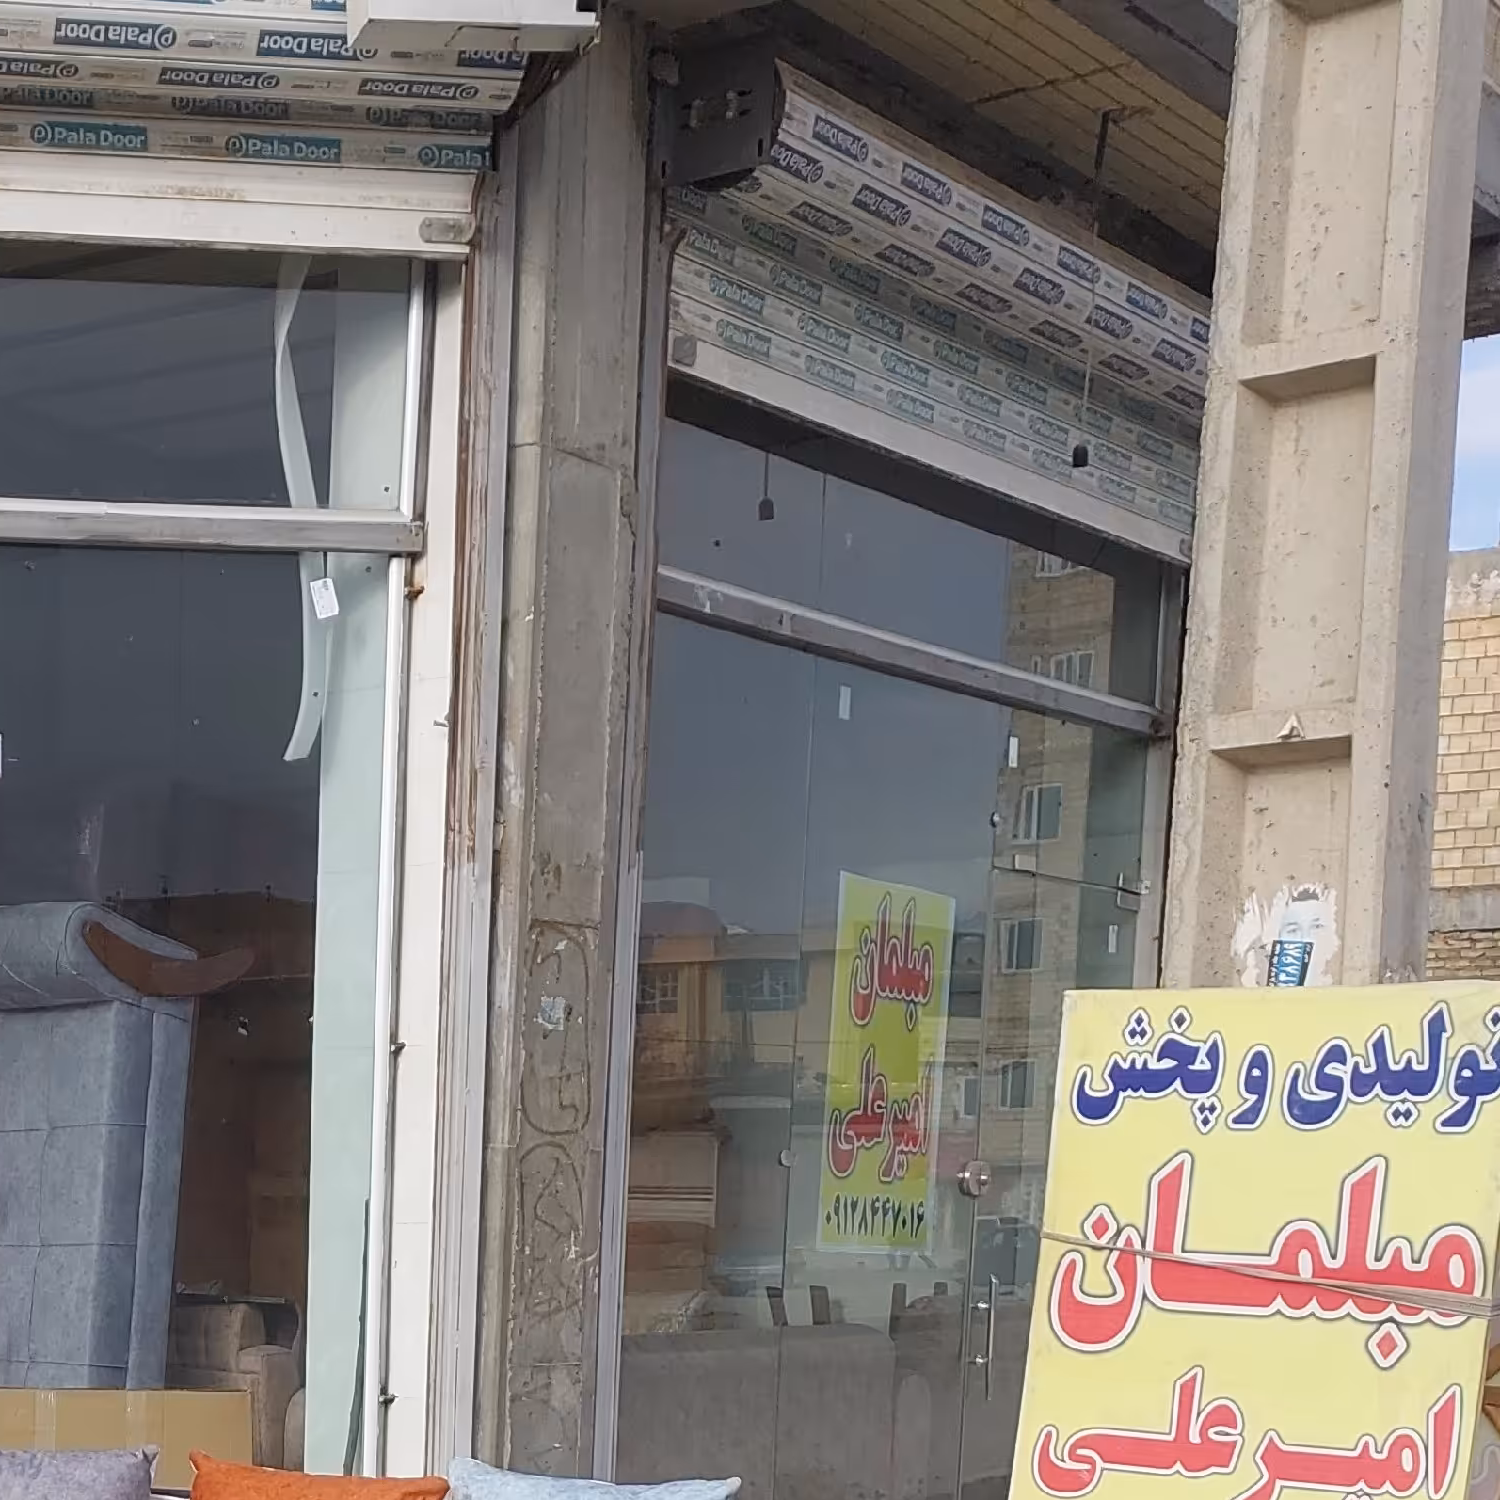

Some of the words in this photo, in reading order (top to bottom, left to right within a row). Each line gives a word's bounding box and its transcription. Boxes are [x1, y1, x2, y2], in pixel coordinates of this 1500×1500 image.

[56, 23, 105, 42] Door
[108, 25, 152, 45] Pala
[260, 34, 307, 54] Door
[10, 61, 55, 75] Pala
[161, 70, 209, 85] Door
[213, 72, 256, 87] Pala
[362, 81, 409, 94] Door
[412, 84, 456, 98] Pala
[54, 127, 96, 145] Pala
[100, 130, 145, 148] Door
[248, 139, 290, 157] Pala
[293, 142, 338, 159] Door
[440, 149, 483, 166] Pala
[771, 144, 791, 167] Doo
[849, 892, 934, 1032] مبلمان
[1072, 1007, 1223, 1132] پخش
[1227, 1045, 1273, 1131] و
[825, 1193, 926, 1239] ۰۹۱۲۸۴۴۷۰۱۶
[1050, 1152, 1484, 1367] مبلمان
